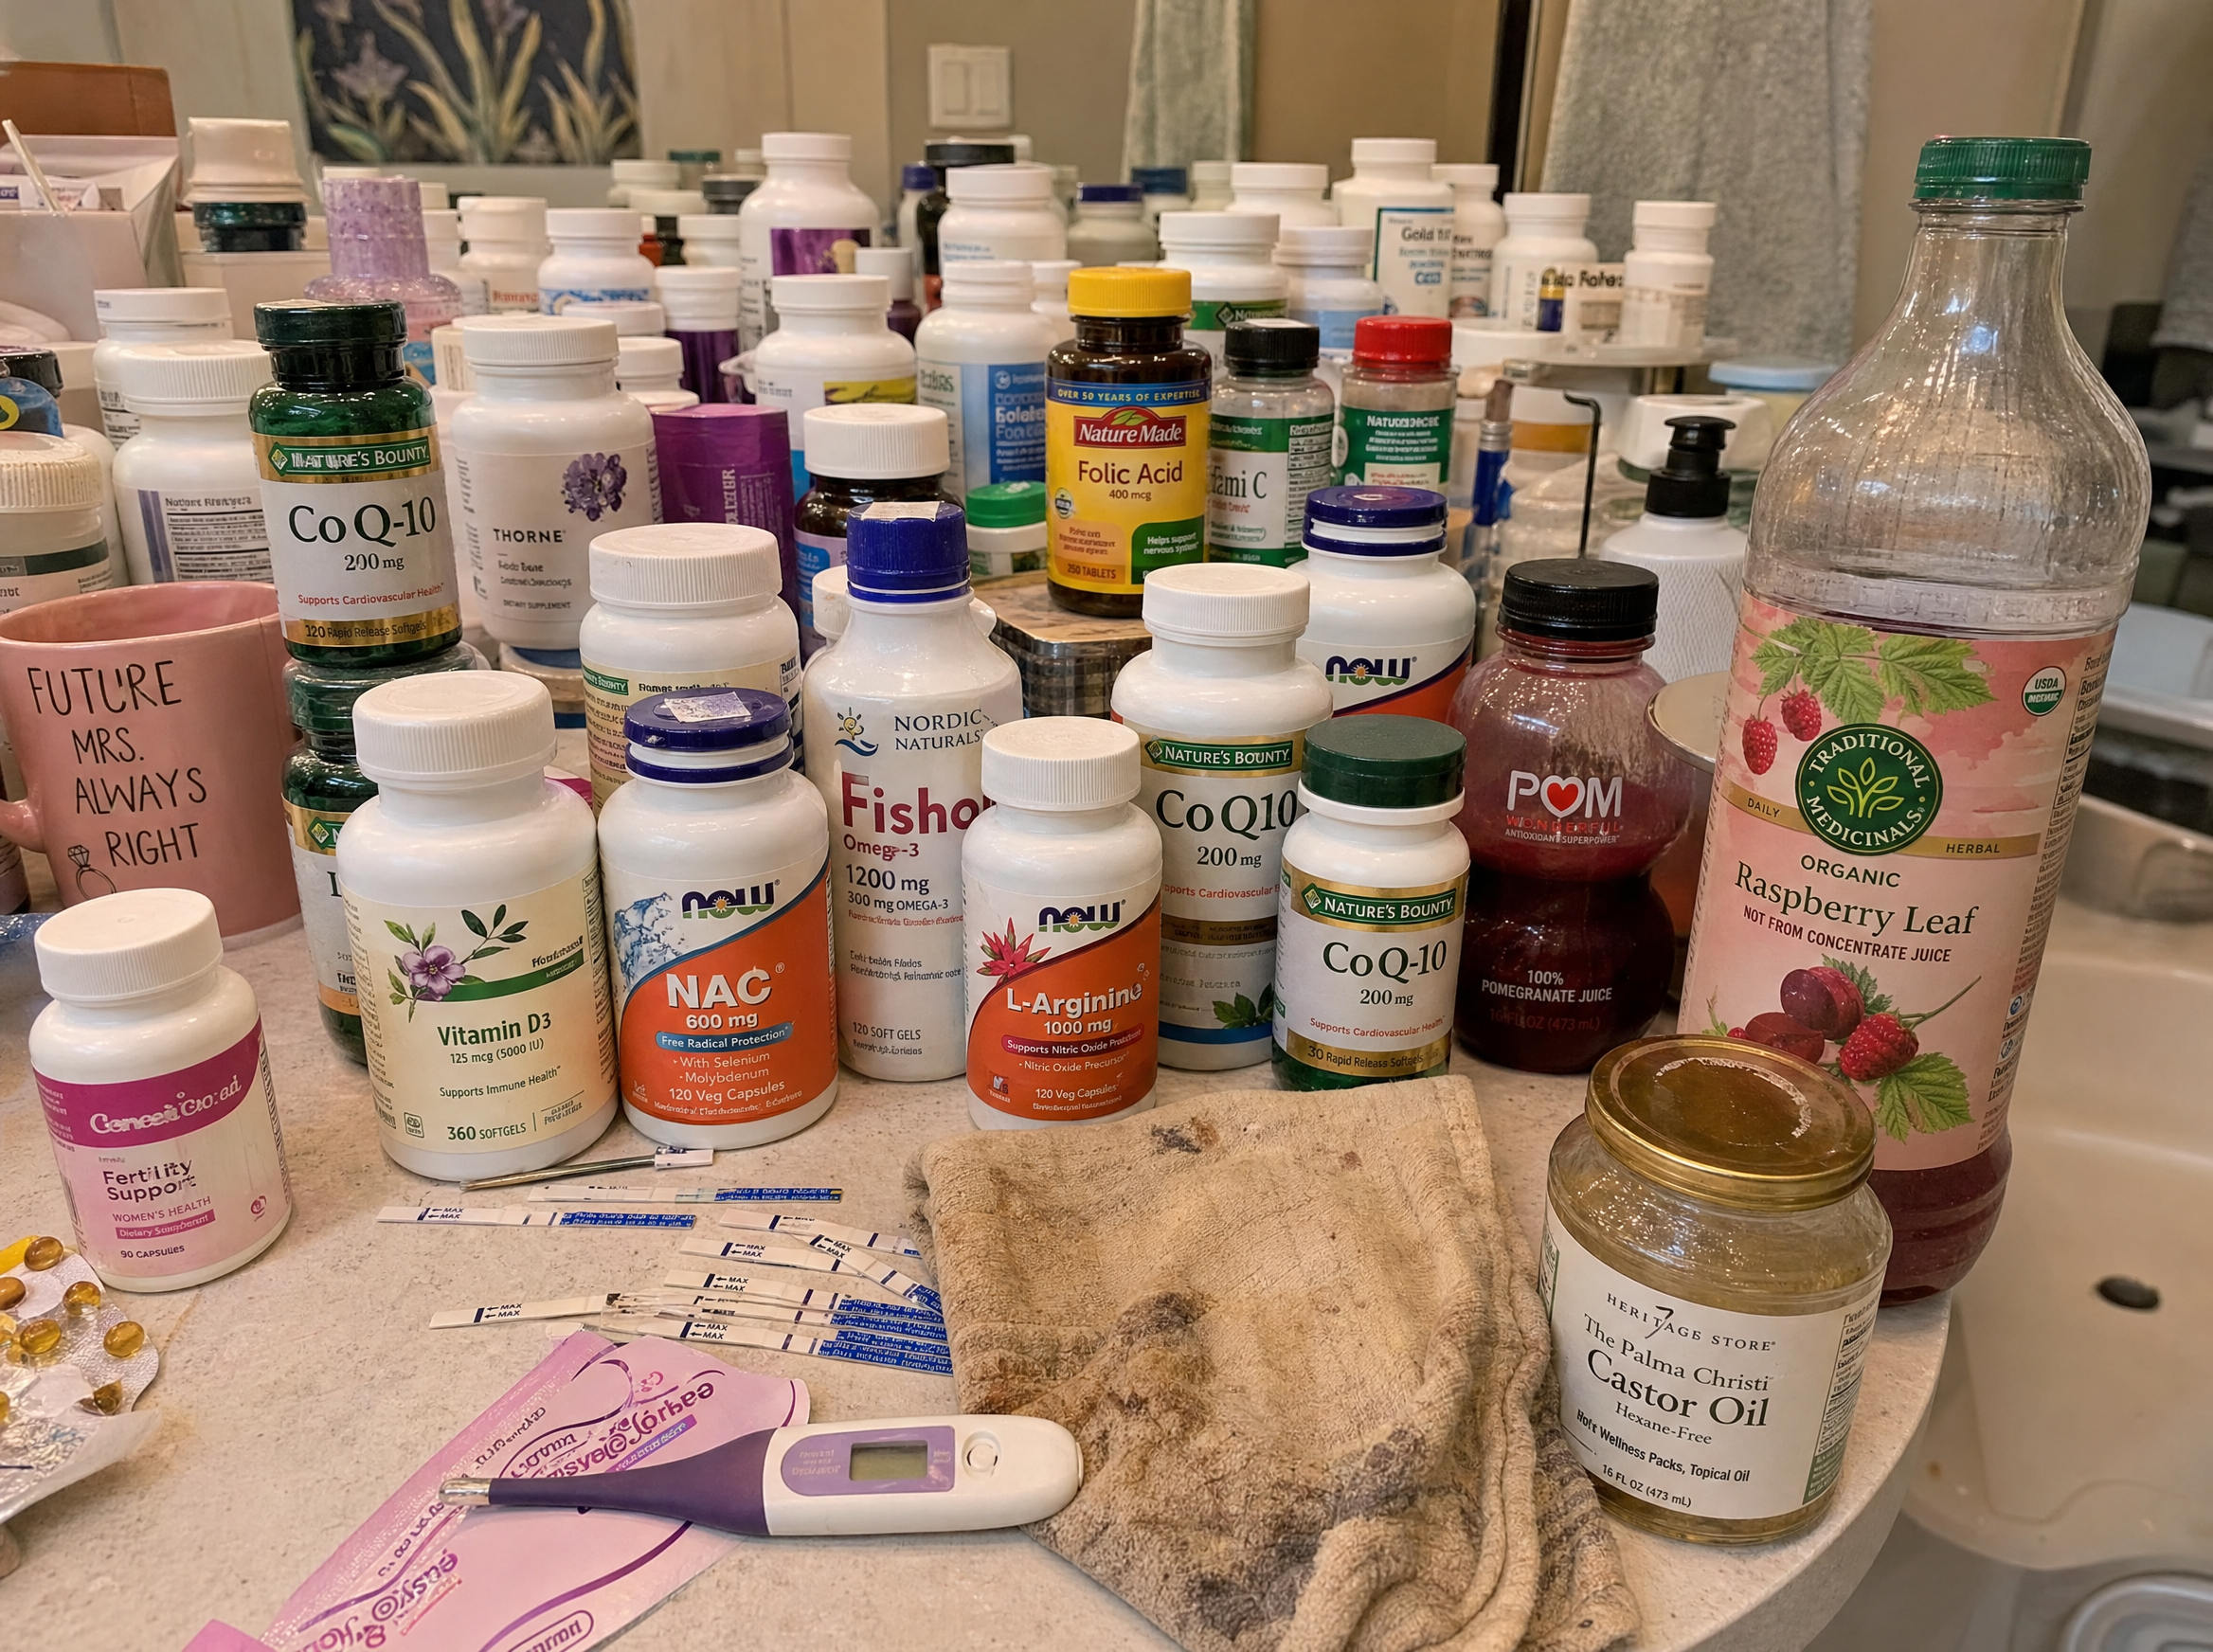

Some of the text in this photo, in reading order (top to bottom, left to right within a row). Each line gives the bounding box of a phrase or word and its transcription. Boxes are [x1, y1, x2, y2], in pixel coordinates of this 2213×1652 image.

[1058, 388, 1199, 402] OVER 50 YEARS OF EXPERTISE
[1079, 423, 1182, 443] Nature Made
[374, 445, 427, 465] BOUNTY
[1078, 460, 1182, 485] Folic Acid
[1253, 471, 1268, 499] C
[1109, 490, 1151, 501] 400 mcg
[493, 528, 563, 543] THORNE
[1147, 532, 1196, 546] Helps support
[1143, 546, 1175, 555] nervous
[344, 553, 405, 571] 200 mg
[1083, 566, 1116, 579] TABLETS
[298, 594, 339, 606] Supports
[342, 591, 416, 605] Cardiovascular
[305, 625, 389, 638] 120 Release
[27, 660, 182, 715] FUTURE
[2035, 678, 2058, 690] USDA
[894, 709, 981, 731] NORDIC
[71, 727, 144, 764] MRS.
[895, 730, 981, 750] NATURALS
[1165, 745, 1288, 764] NATURE'S BOUNTY
[1808, 733, 1930, 789] TRADITIONAL
[76, 767, 207, 815] ALWAYS
[1506, 770, 1623, 818] POM
[1747, 798, 1781, 817] DAILY
[1807, 796, 1923, 847] MEDICINALS
[104, 822, 199, 868] RIGHT
[1505, 828, 1561, 843] ANTIOXIDANT
[1196, 846, 1262, 868] 200 mg
[1946, 842, 2001, 854] HERBAL
[846, 864, 929, 895] 1200 mg
[1801, 854, 1901, 888] ORGANIC
[848, 891, 948, 913] 300 mg OMEGA-3
[1198, 886, 1272, 899] Cardiovascular
[1735, 860, 1979, 938] Raspberry Leaf
[1324, 897, 1452, 919] NATURE'S BOUNTY
[1744, 905, 1952, 962] NOT FROM CONCENTRATE JUICE
[1527, 969, 1564, 985] 100%
[666, 968, 772, 1010] NAC
[1359, 989, 1413, 1006] 200 mg
[1482, 979, 1612, 1002] POMEGRANATE JUICE
[1007, 982, 1142, 1019] L-Arginine
[437, 1012, 551, 1047] Vitamin D3
[686, 1013, 759, 1030] 600 mg
[853, 1022, 921, 1040] 120 SOFT GELS
[1044, 1019, 1112, 1034] 1000 mg
[1310, 1017, 1420, 1037] Supports Cardiovascular
[1527, 1015, 1600, 1032] OZ (473 mL)
[662, 1030, 785, 1049] Free Radical Protection
[1008, 1039, 1107, 1054] Supports Nitric Oxide
[450, 1038, 544, 1064] 125 mcg (5000 IU)
[680, 1052, 770, 1068] With Selenium
[1307, 1046, 1352, 1067] 30 Rapid
[1024, 1060, 1051, 1072] Nitric
[1053, 1060, 1082, 1071] Oxide
[440, 1068, 557, 1099] Supports Immune Health
[685, 1068, 769, 1086] Molybdenum
[669, 1088, 692, 1102] 120
[695, 1089, 722, 1104] Veg
[727, 1081, 784, 1101] Capsules
[1035, 1088, 1053, 1099] 120
[1055, 1089, 1075, 1101] Veg
[447, 1123, 527, 1140] 360 SOFTGELS
[113, 1196, 211, 1223] WOMEN'S HEALTH
[1607, 1293, 1772, 1352] HERITAGE STORE
[1584, 1313, 1769, 1392] The Palma Christi
[1588, 1349, 1769, 1427] Castor Oil
[1615, 1401, 1712, 1445] Hexane-Free
[1599, 1426, 1750, 1481] Wellness Packs, Topical Oil
[1602, 1464, 1692, 1507] 16 FL OZ (473 mL)
